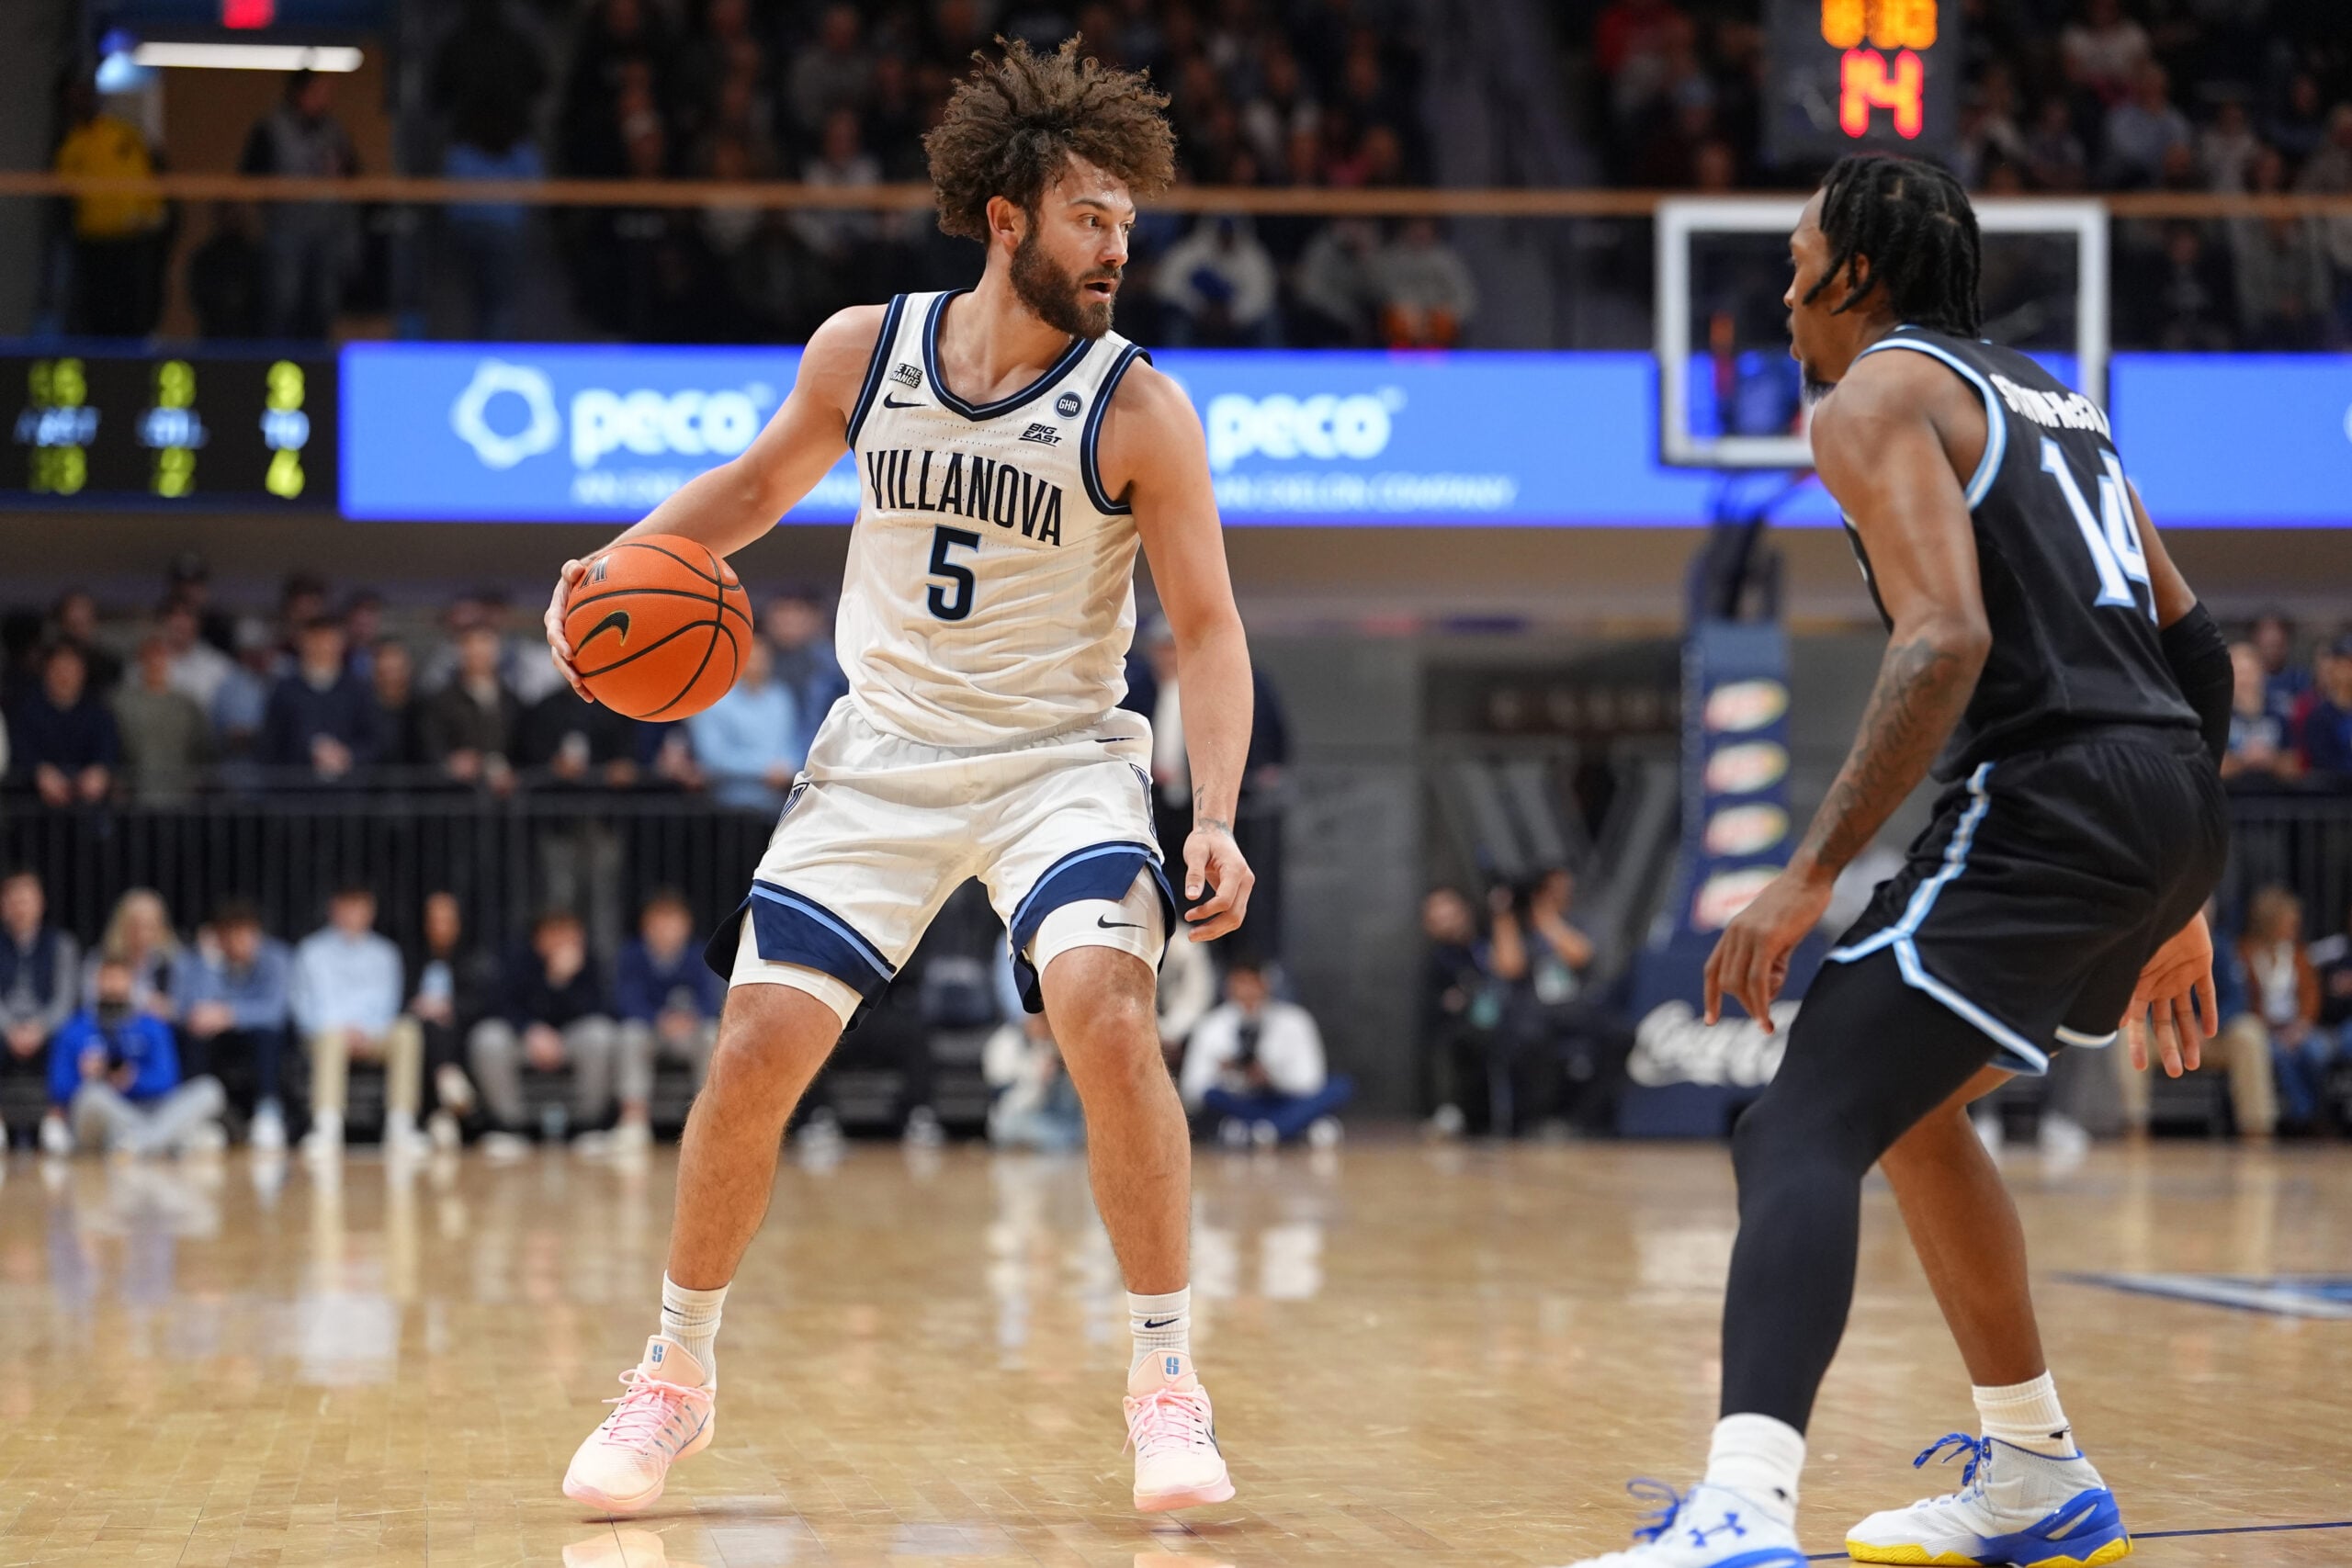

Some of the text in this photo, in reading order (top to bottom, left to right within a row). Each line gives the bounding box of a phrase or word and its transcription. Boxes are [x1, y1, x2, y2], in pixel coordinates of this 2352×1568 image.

[891, 371, 920, 387] ANGE
[904, 366, 922, 378] THE
[1058, 398, 1079, 412] GHR
[1028, 423, 1057, 435] BIG
[1022, 430, 1062, 444] EAST
[865, 449, 1063, 547] VILLANOVA
[2040, 434, 2159, 626] 14
[925, 523, 982, 622] 5
